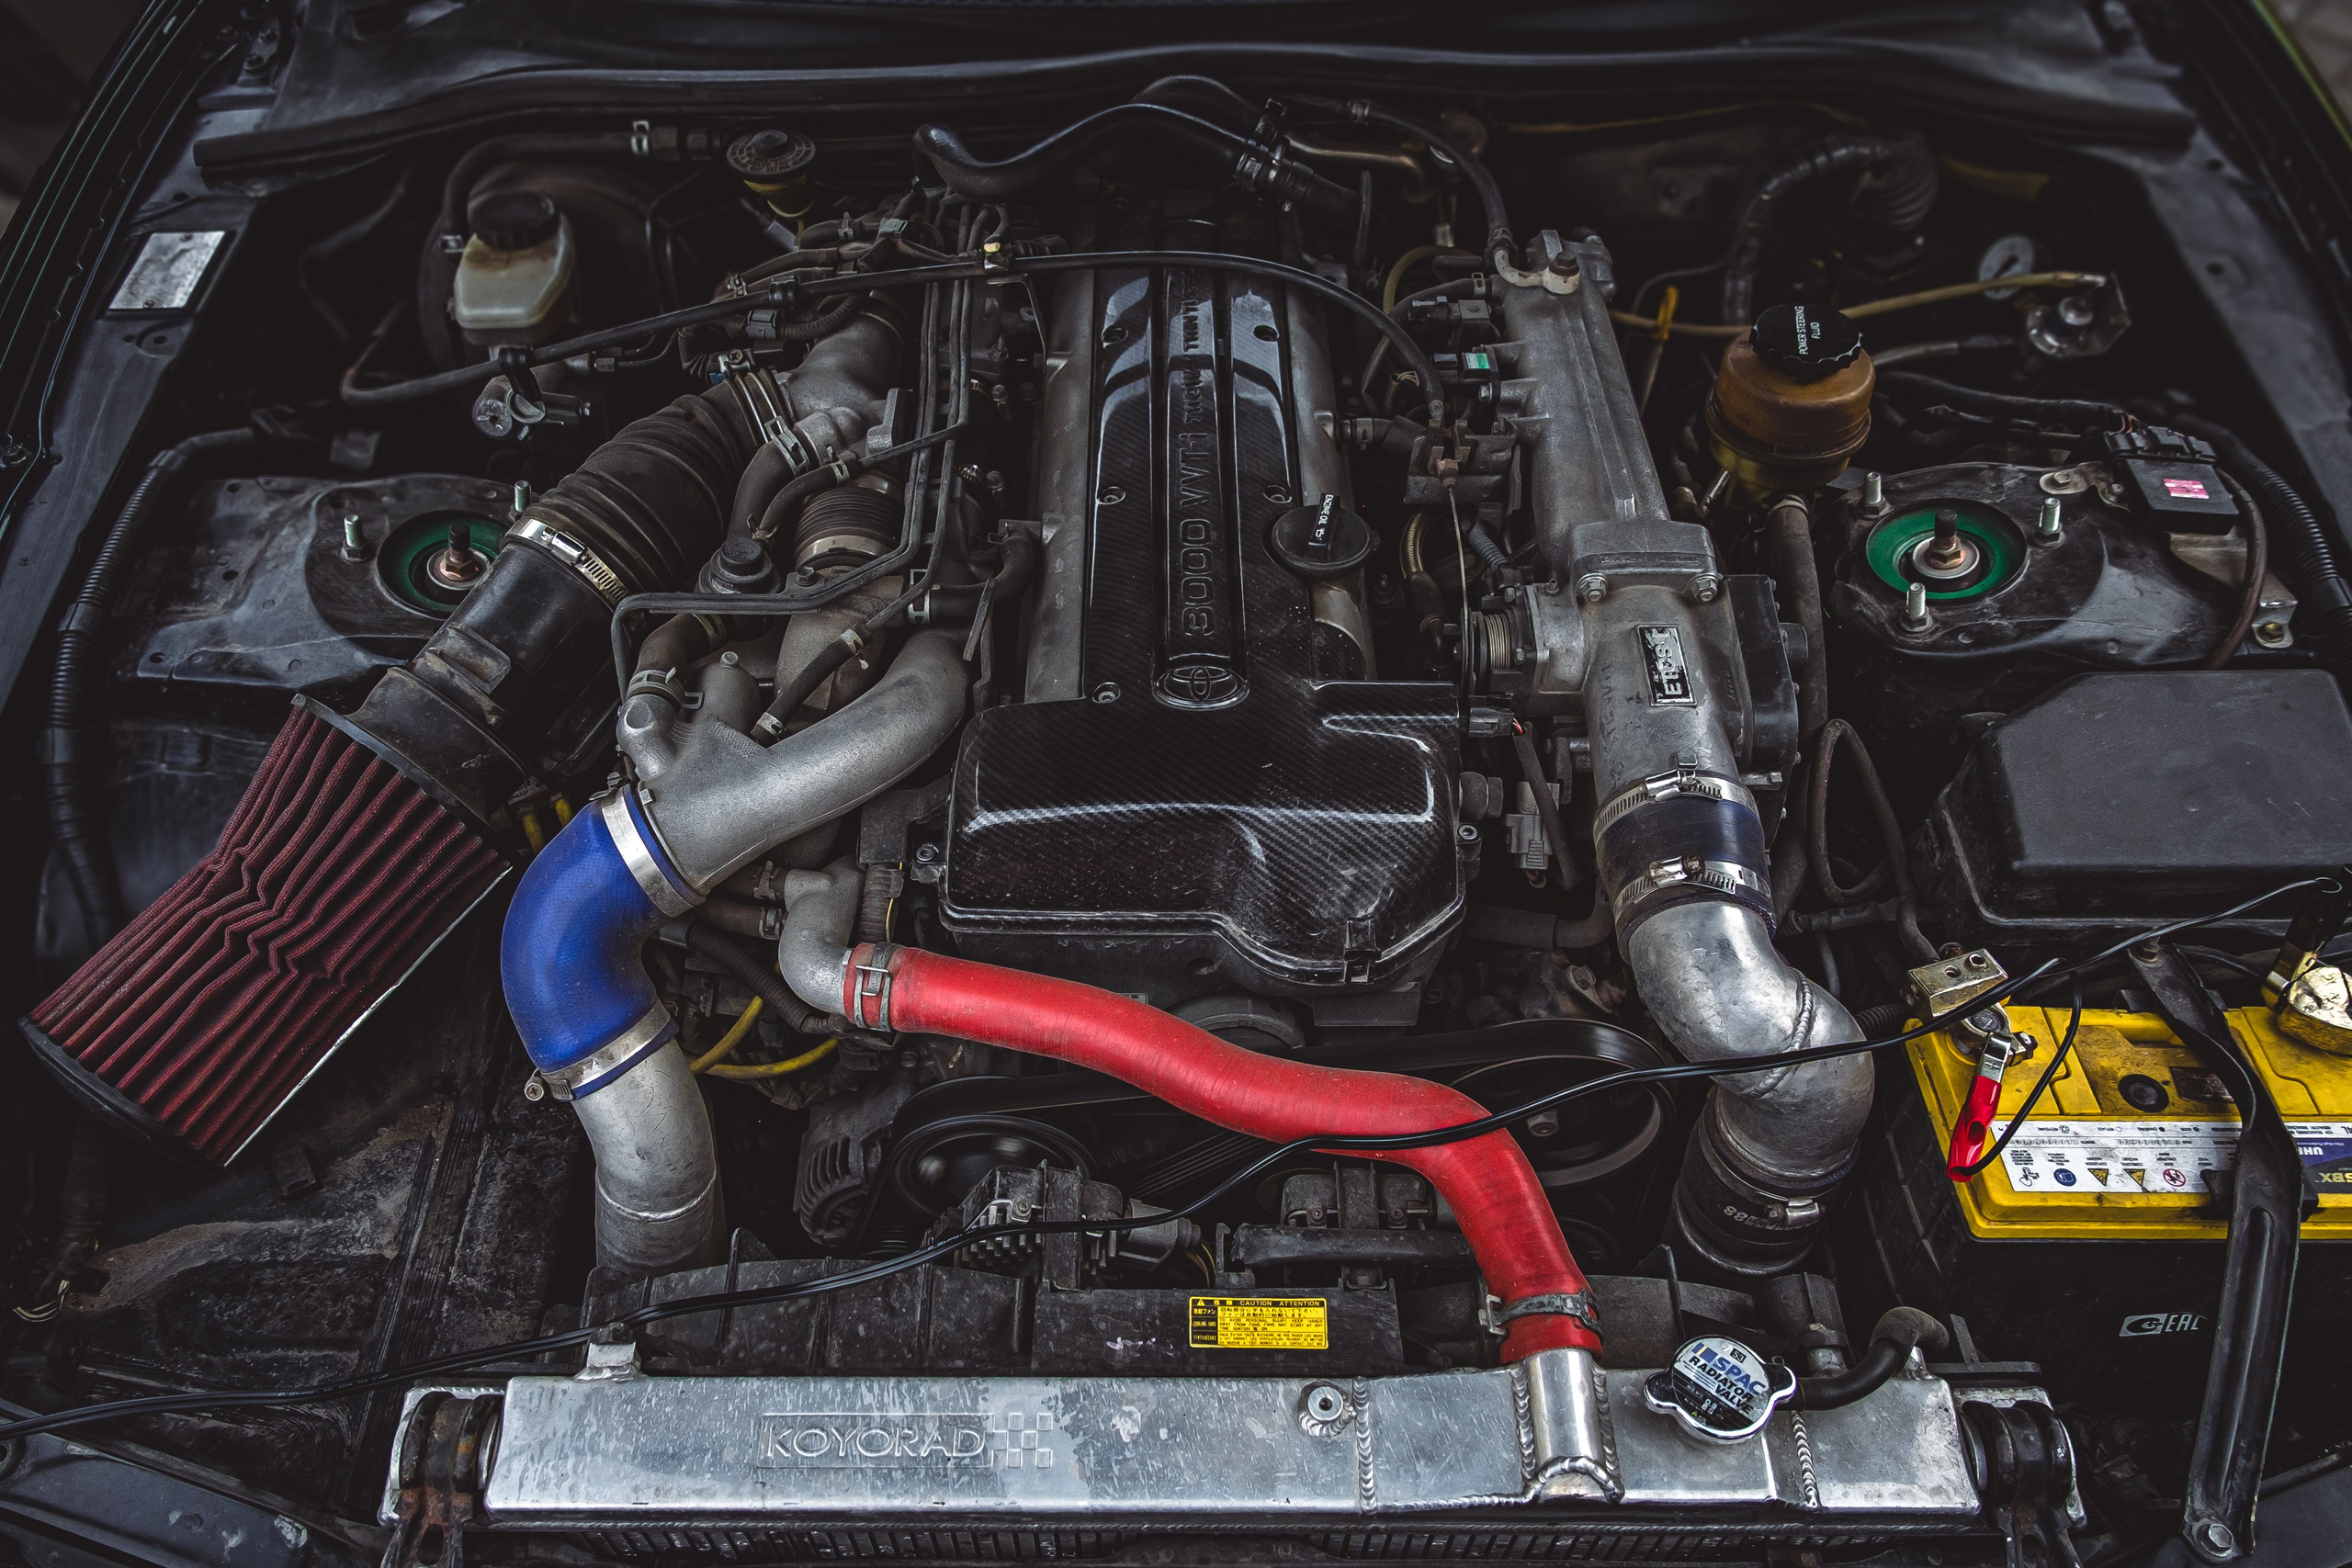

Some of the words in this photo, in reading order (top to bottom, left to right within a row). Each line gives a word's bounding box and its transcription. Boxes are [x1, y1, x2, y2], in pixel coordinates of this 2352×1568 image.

[1795, 306, 1806, 333] STEERING
[1810, 322, 1821, 339] FLUID
[1798, 334, 1808, 355] POWER
[1178, 433, 1210, 507] VVT-i
[1321, 494, 1334, 515] ENGINE
[1318, 515, 1328, 525] OIL
[1181, 519, 1213, 636] 3000
[1732, 1350, 1745, 1362] 53
[1688, 1356, 1754, 1402] RADIATOR
[1713, 1357, 1766, 1395] SPAC
[1713, 1384, 1753, 1414] VALVE
[766, 1427, 986, 1458] KOYORAD
